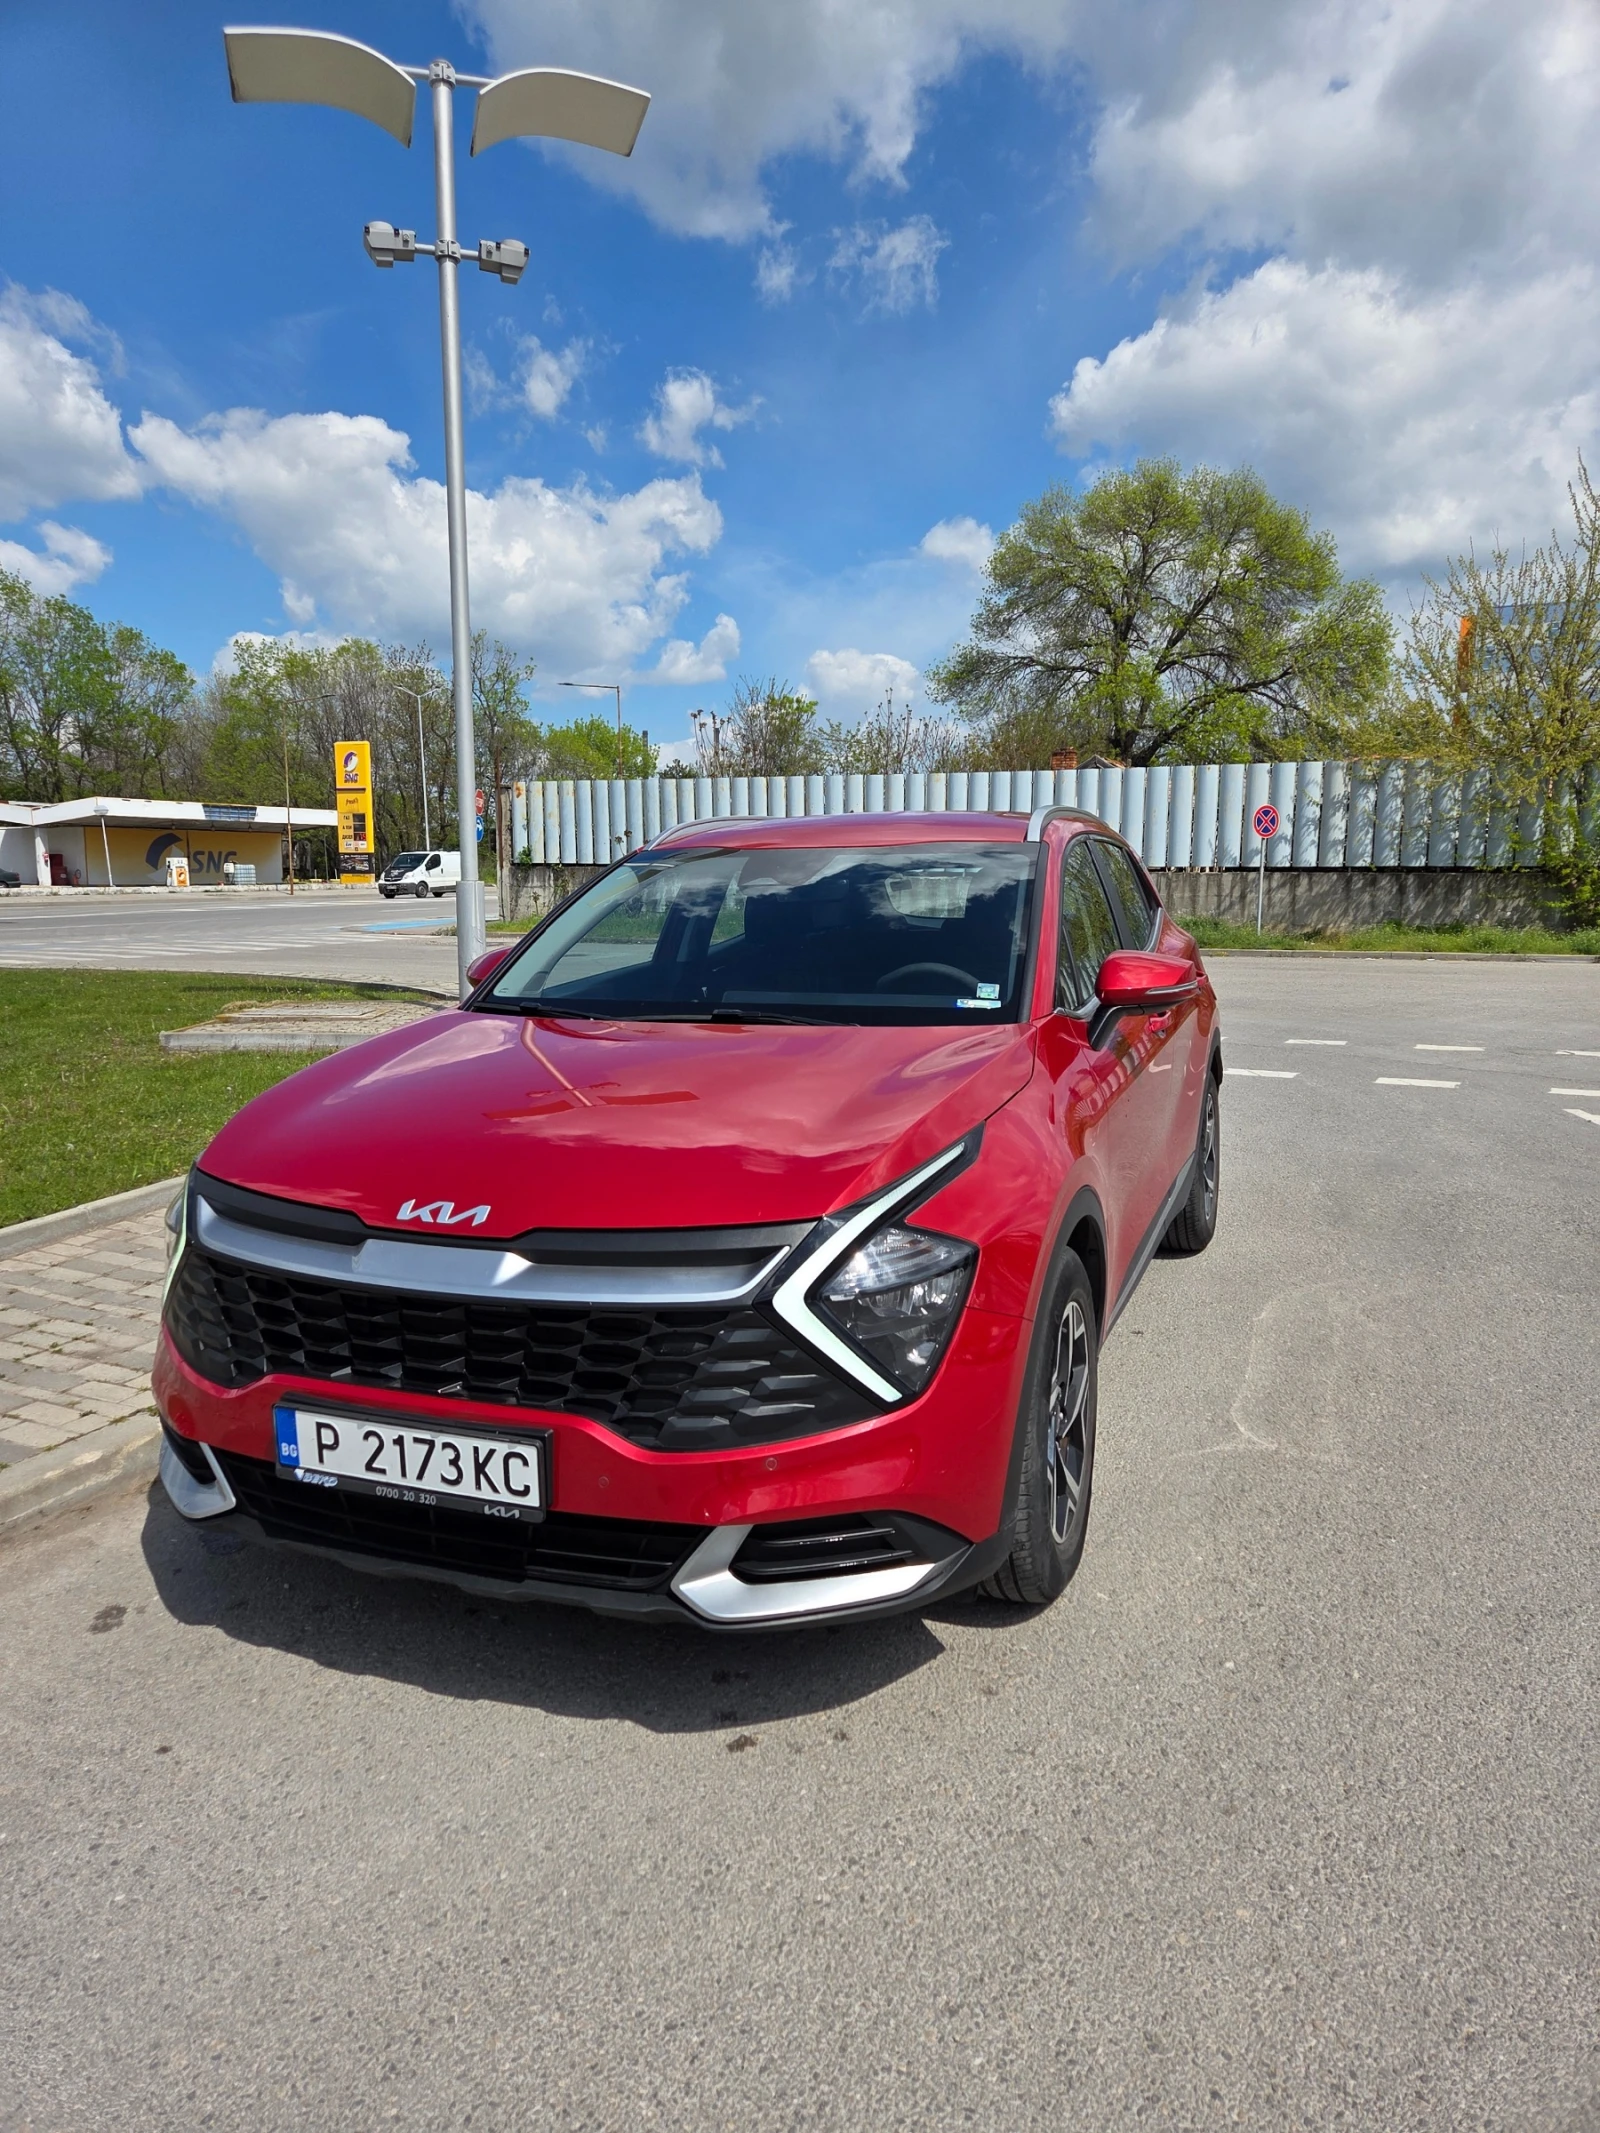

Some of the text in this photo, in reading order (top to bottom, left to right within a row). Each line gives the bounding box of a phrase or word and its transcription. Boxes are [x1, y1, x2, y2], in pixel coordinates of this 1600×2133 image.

[396, 1198, 492, 1227] KIA
[281, 1442, 298, 1457] BG
[375, 1486, 437, 1506] 0700 20 320
[484, 1504, 520, 1519] KIA
